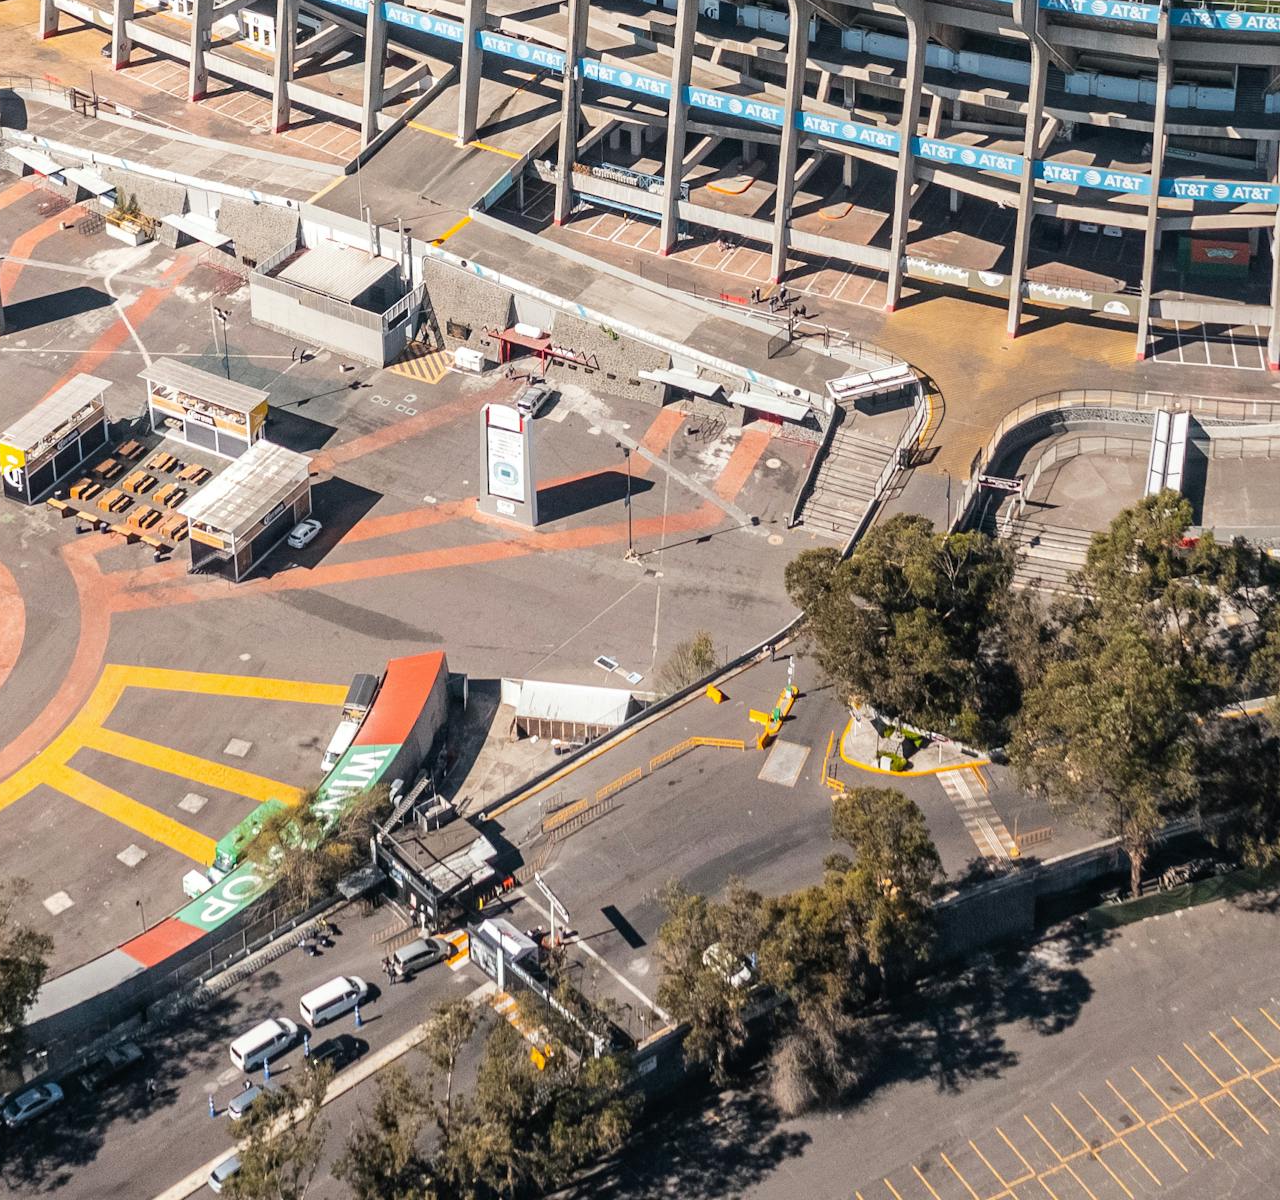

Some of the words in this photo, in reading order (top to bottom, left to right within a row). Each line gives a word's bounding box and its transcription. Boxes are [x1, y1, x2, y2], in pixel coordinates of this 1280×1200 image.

[388, 7, 416, 25] AT&T
[434, 22, 464, 39] AT&T
[1111, 4, 1150, 21] AT&T
[1181, 11, 1220, 27] AT&T
[483, 36, 513, 52] AT&T
[532, 49, 562, 66] AT&T
[583, 63, 616, 80] AT&T
[635, 76, 668, 94] AT&T
[691, 92, 725, 109] AT&T
[745, 106, 780, 122] AT&T
[803, 116, 838, 133] AT&T
[859, 130, 895, 147] AT&T
[920, 143, 956, 159] AT&T
[979, 155, 1016, 170] AT&T
[1043, 166, 1081, 182] AT&T
[1104, 175, 1144, 191] AT&T
[1170, 184, 1208, 198] AT&T
[1232, 188, 1272, 201] AT&T
